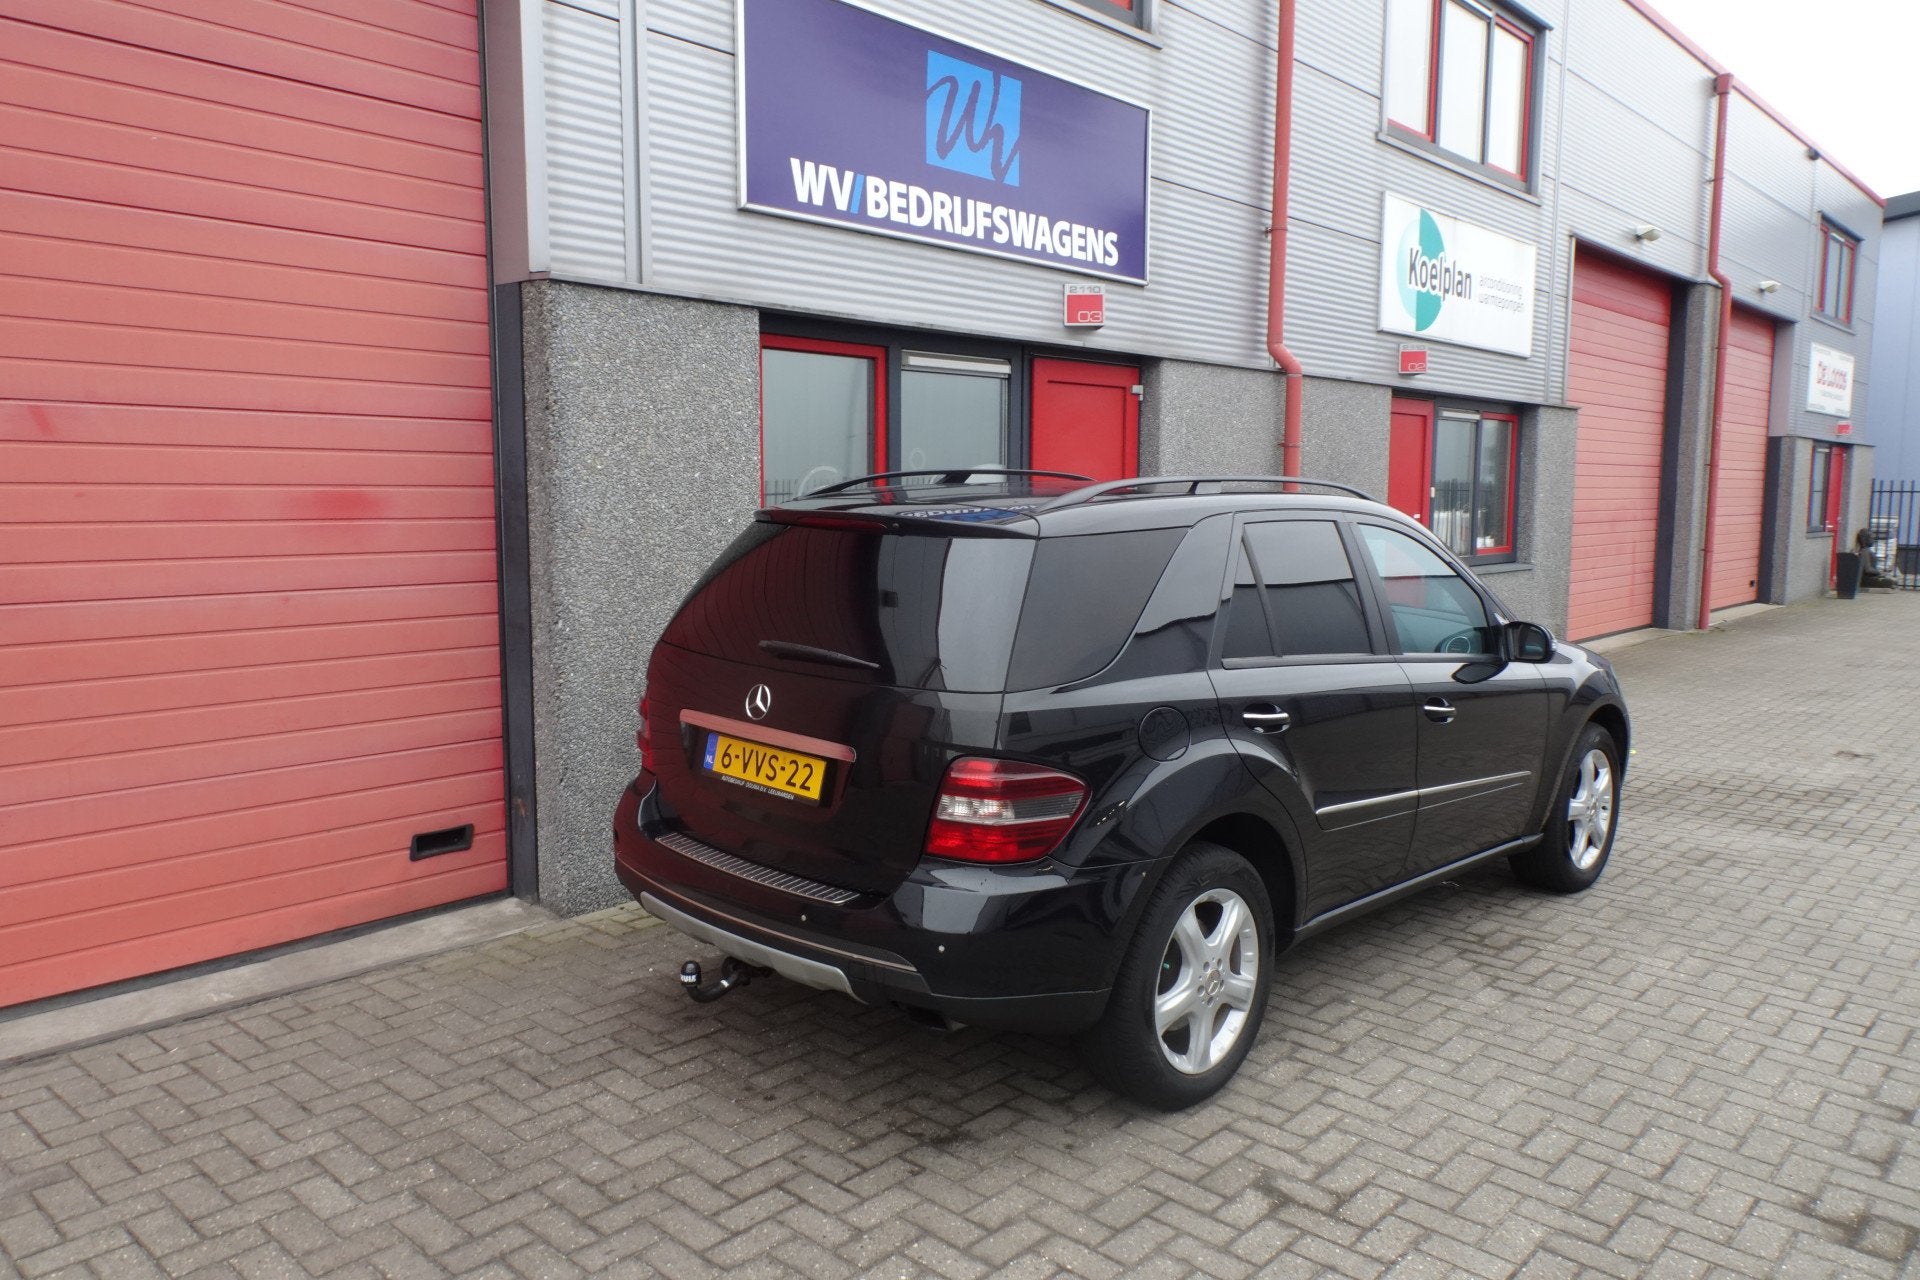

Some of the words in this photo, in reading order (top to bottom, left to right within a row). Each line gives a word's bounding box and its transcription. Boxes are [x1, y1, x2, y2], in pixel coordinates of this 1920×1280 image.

[1408, 248, 1472, 301] Koelplan
[1078, 310, 1102, 323] 03
[1408, 362, 1426, 371] 02
[706, 754, 714, 764] NL
[721, 743, 814, 792] 6-VVS-22
